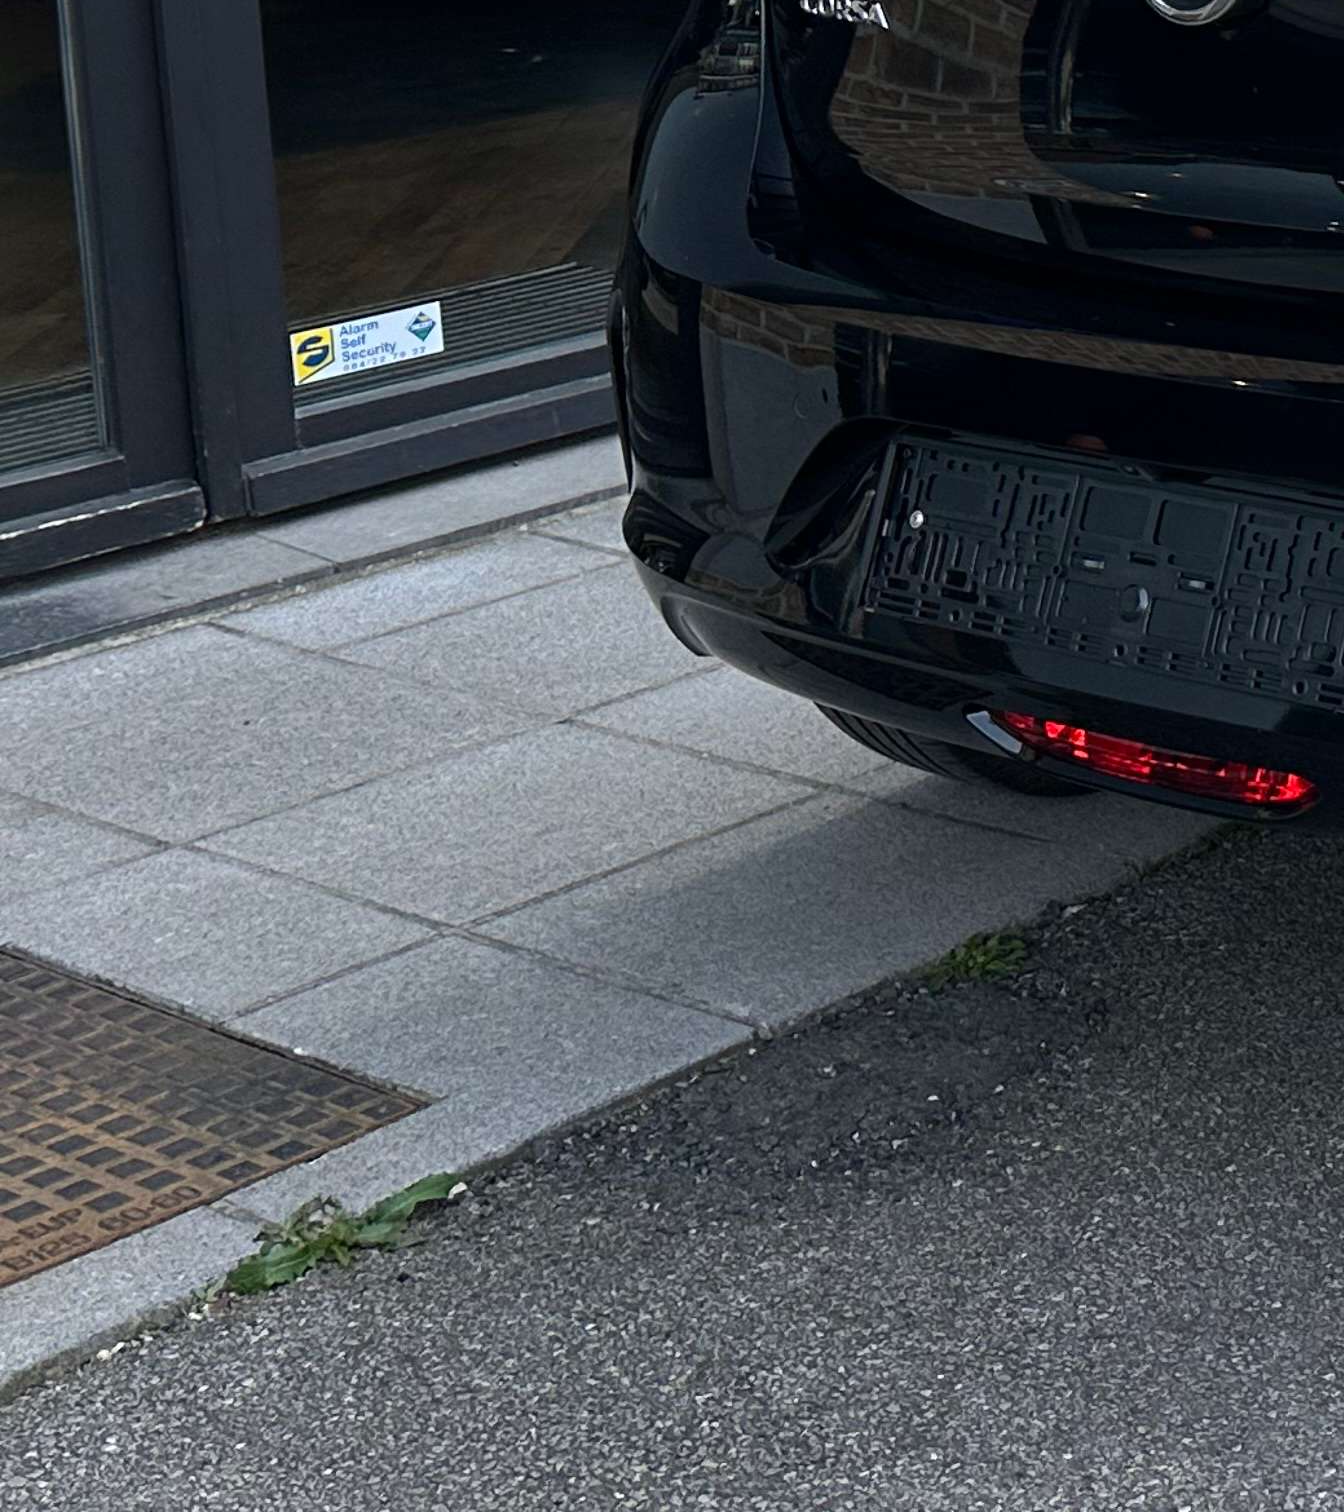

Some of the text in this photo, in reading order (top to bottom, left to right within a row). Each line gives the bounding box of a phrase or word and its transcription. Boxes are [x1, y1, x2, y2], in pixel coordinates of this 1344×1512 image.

[339, 320, 379, 337] Alarm
[341, 334, 366, 349] Self
[342, 342, 396, 362] Security
